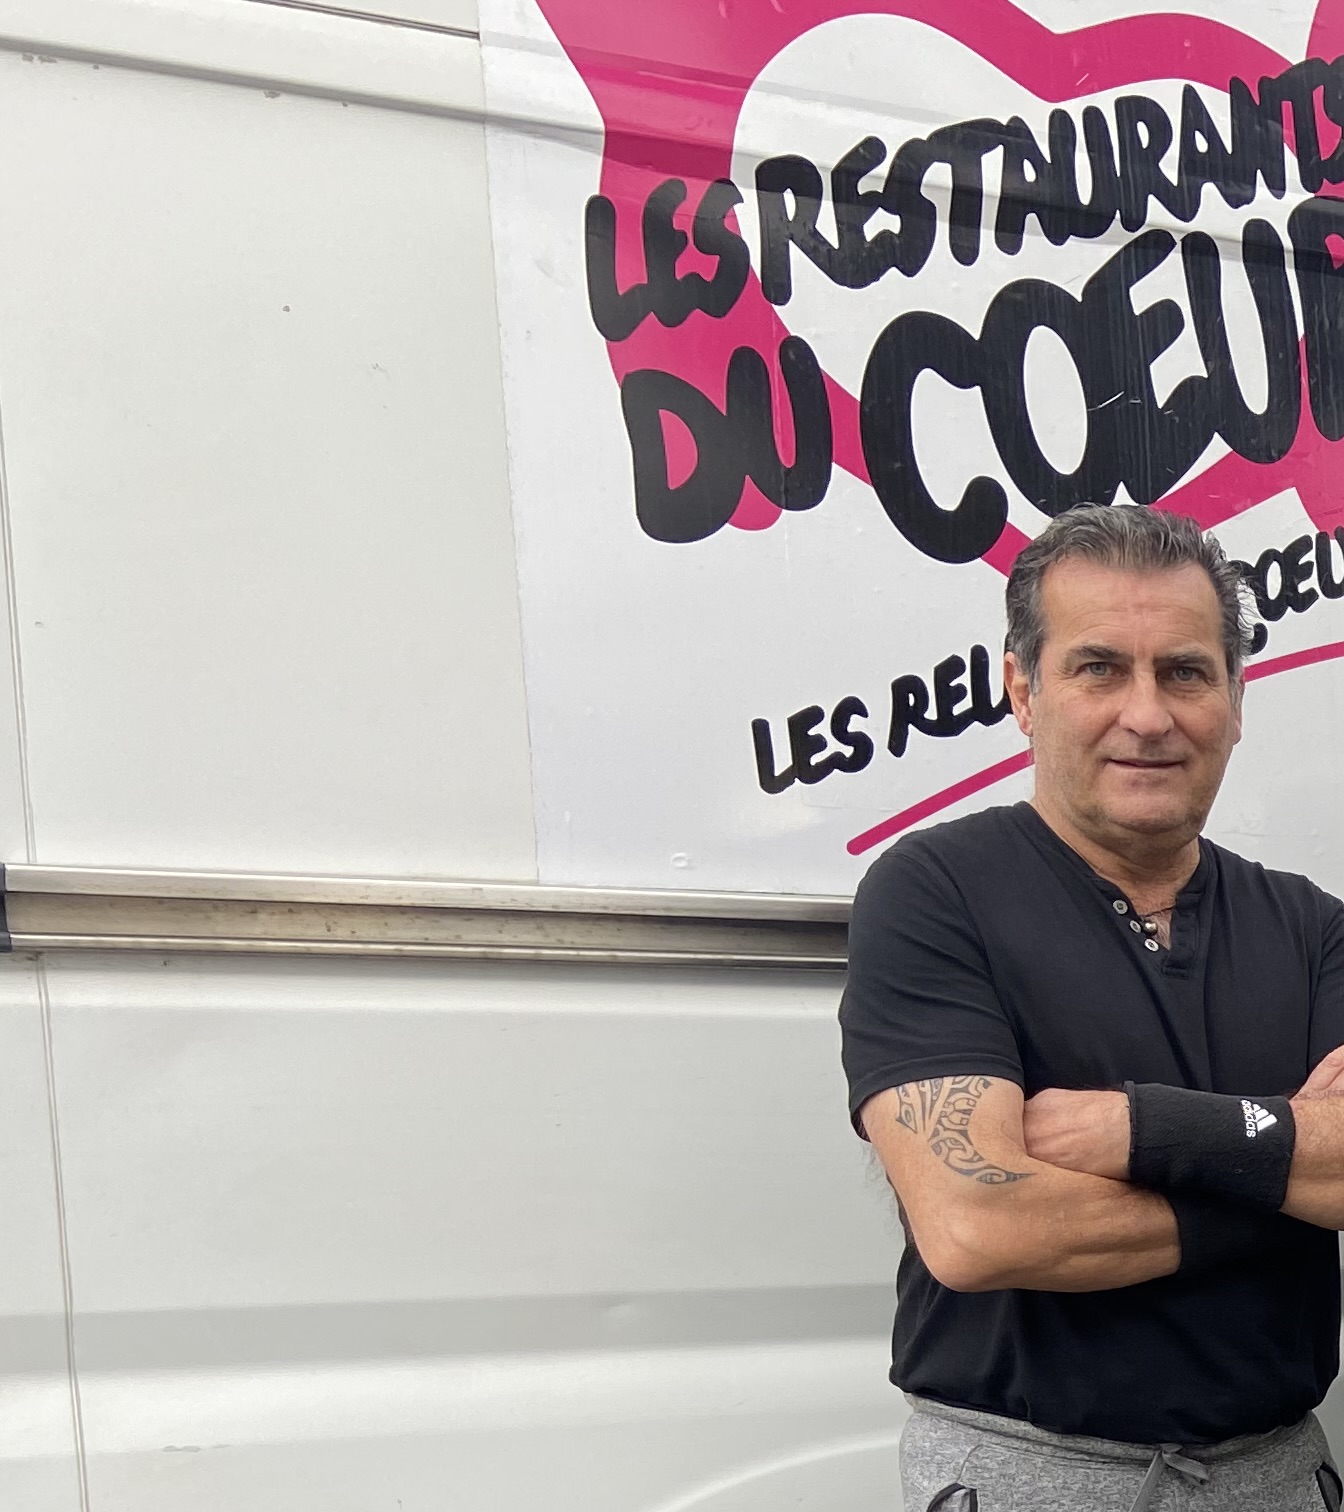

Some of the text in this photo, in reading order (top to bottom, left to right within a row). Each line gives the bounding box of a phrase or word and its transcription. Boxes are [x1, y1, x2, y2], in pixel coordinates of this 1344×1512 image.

[586, 178, 750, 341] LES
[621, 336, 833, 543] DU
[751, 695, 874, 794] LES
[1241, 1099, 1256, 1137] adidas
